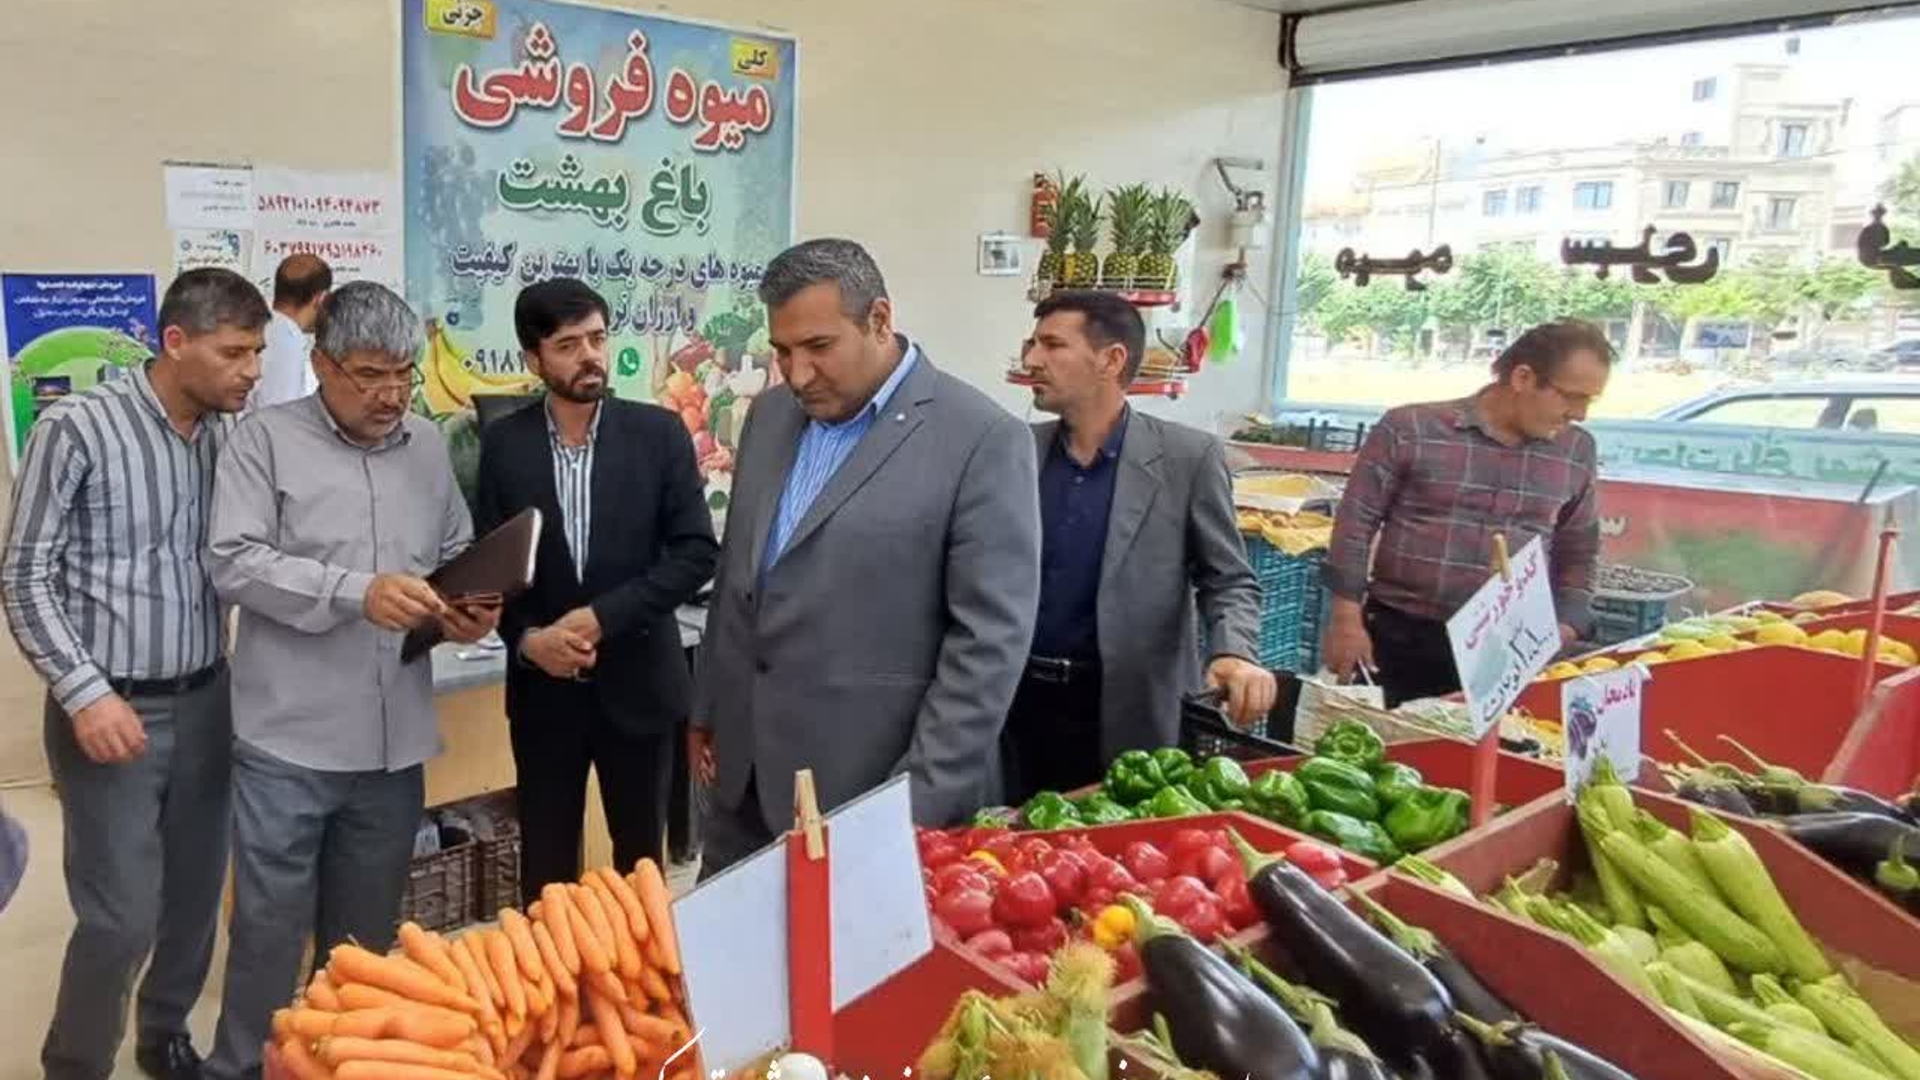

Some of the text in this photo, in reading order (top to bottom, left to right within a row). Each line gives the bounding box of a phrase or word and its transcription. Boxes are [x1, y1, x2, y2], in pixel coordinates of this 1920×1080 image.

[737, 49, 768, 70] کلی
[454, 22, 771, 150] میوه فروشی
[498, 154, 711, 235] باغ بهشت
[452, 243, 517, 285] کیفیت
[606, 249, 634, 287] یک
[691, 252, 727, 288] های
